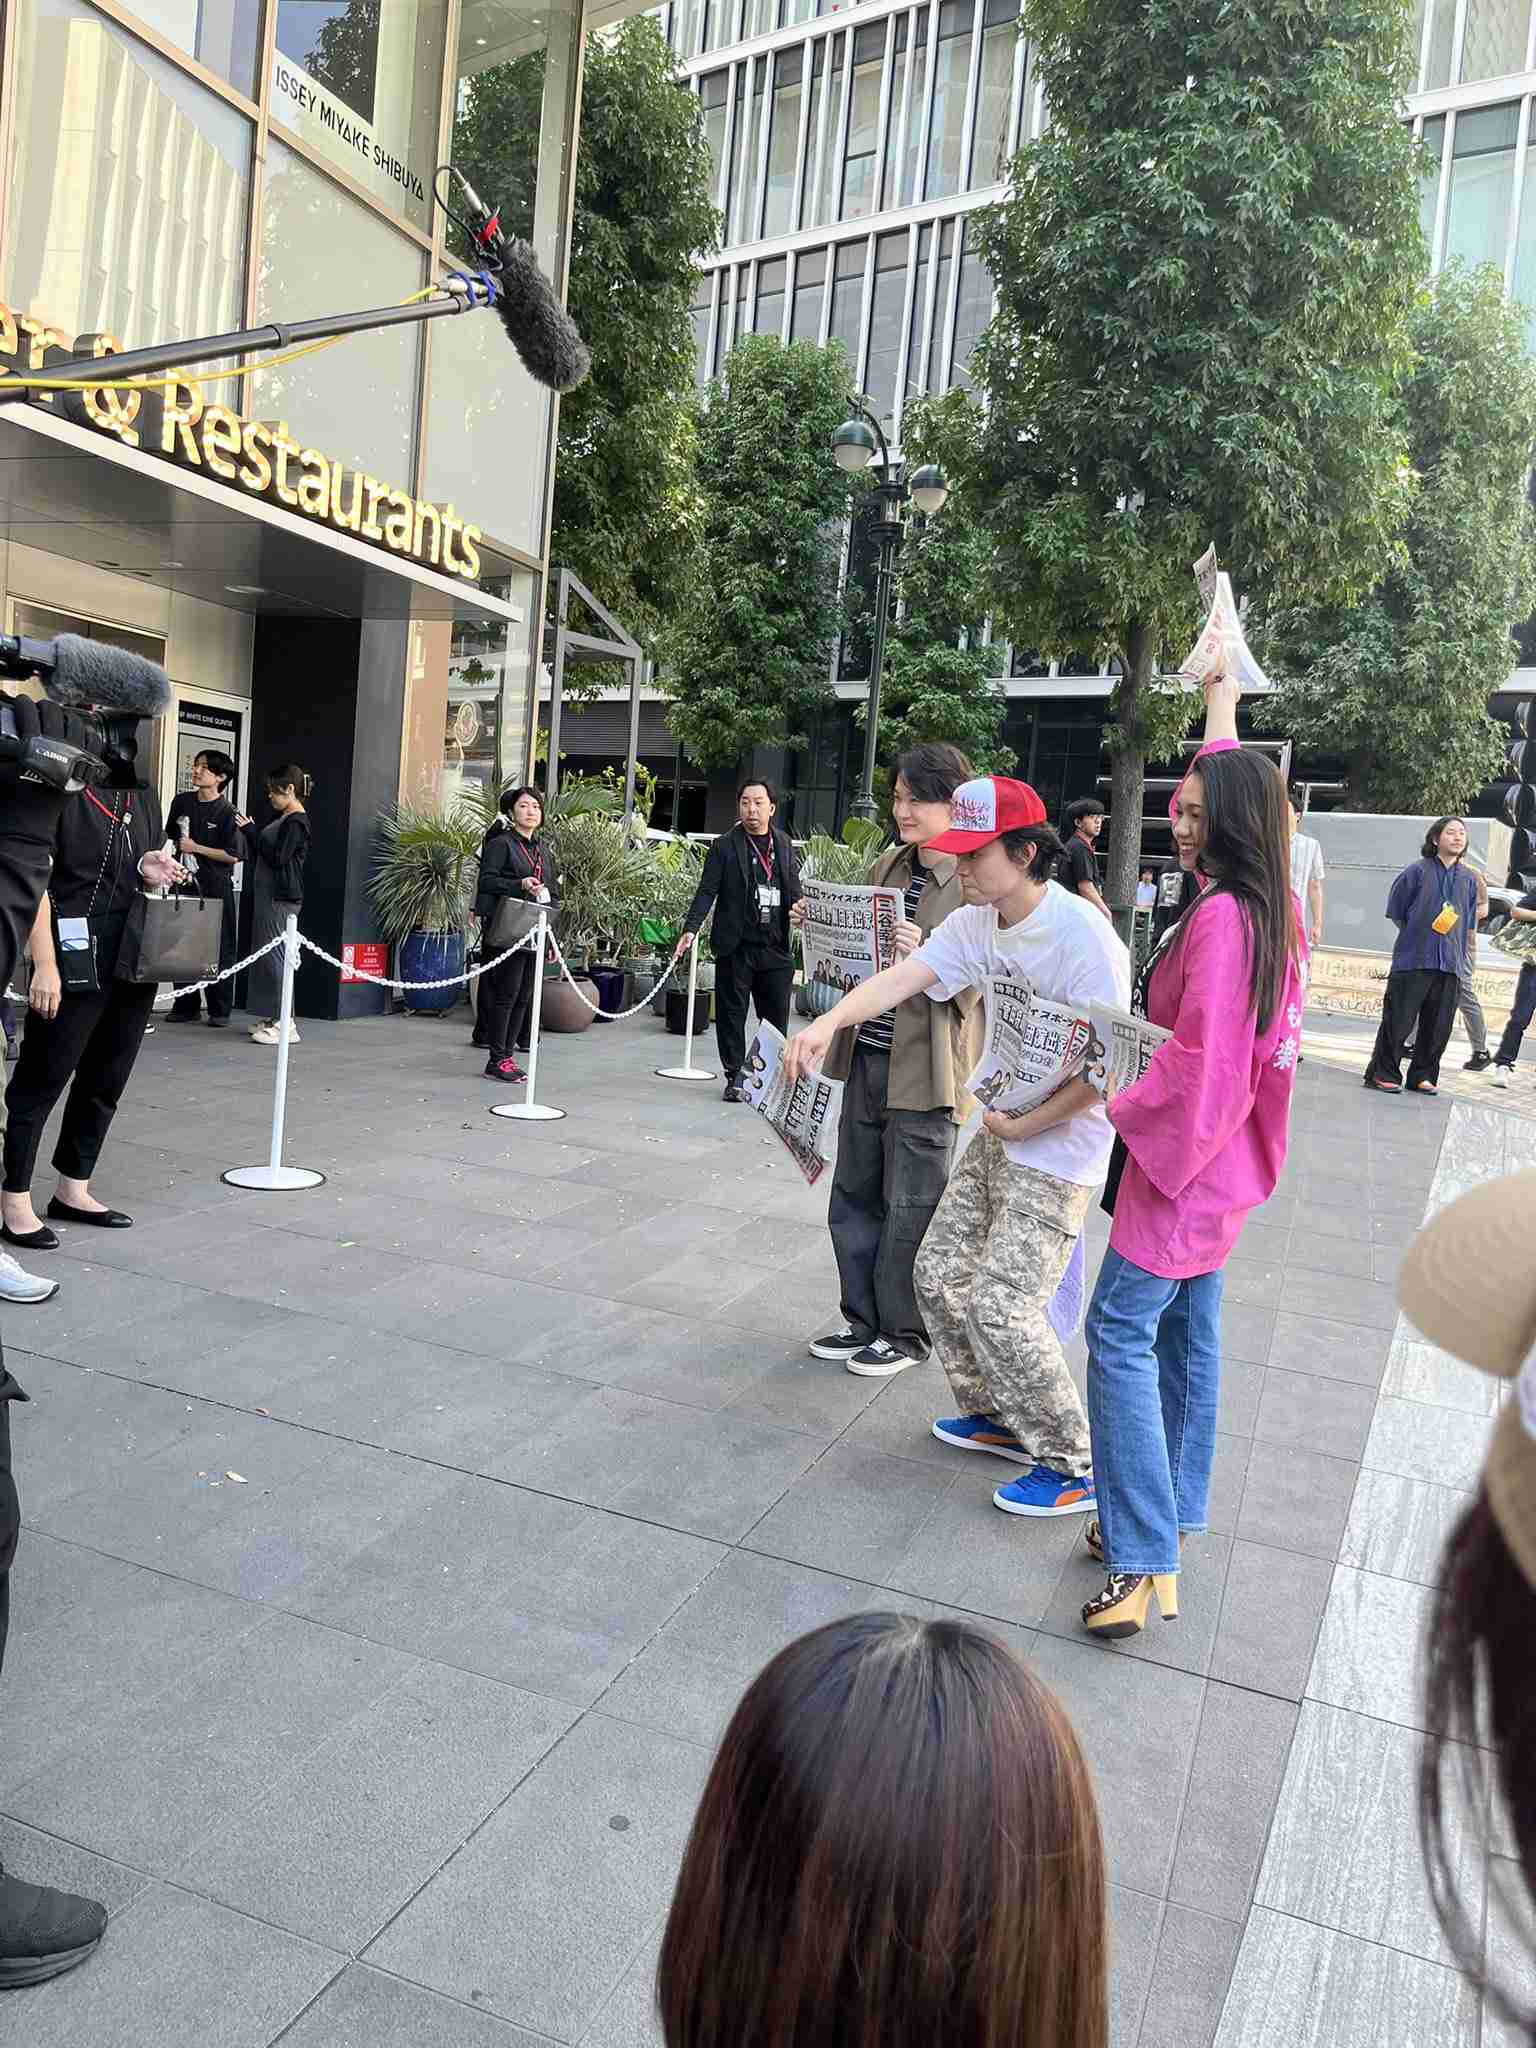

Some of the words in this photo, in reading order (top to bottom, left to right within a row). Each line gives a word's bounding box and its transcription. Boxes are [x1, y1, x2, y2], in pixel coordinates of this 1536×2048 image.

[275, 66, 317, 112] ISSEY
[320, 101, 370, 158] MIYAKE
[373, 145, 425, 202] SHIBUYA
[161, 369, 482, 580] Restaurants
[820, 888, 874, 904] サンケイスポーツ
